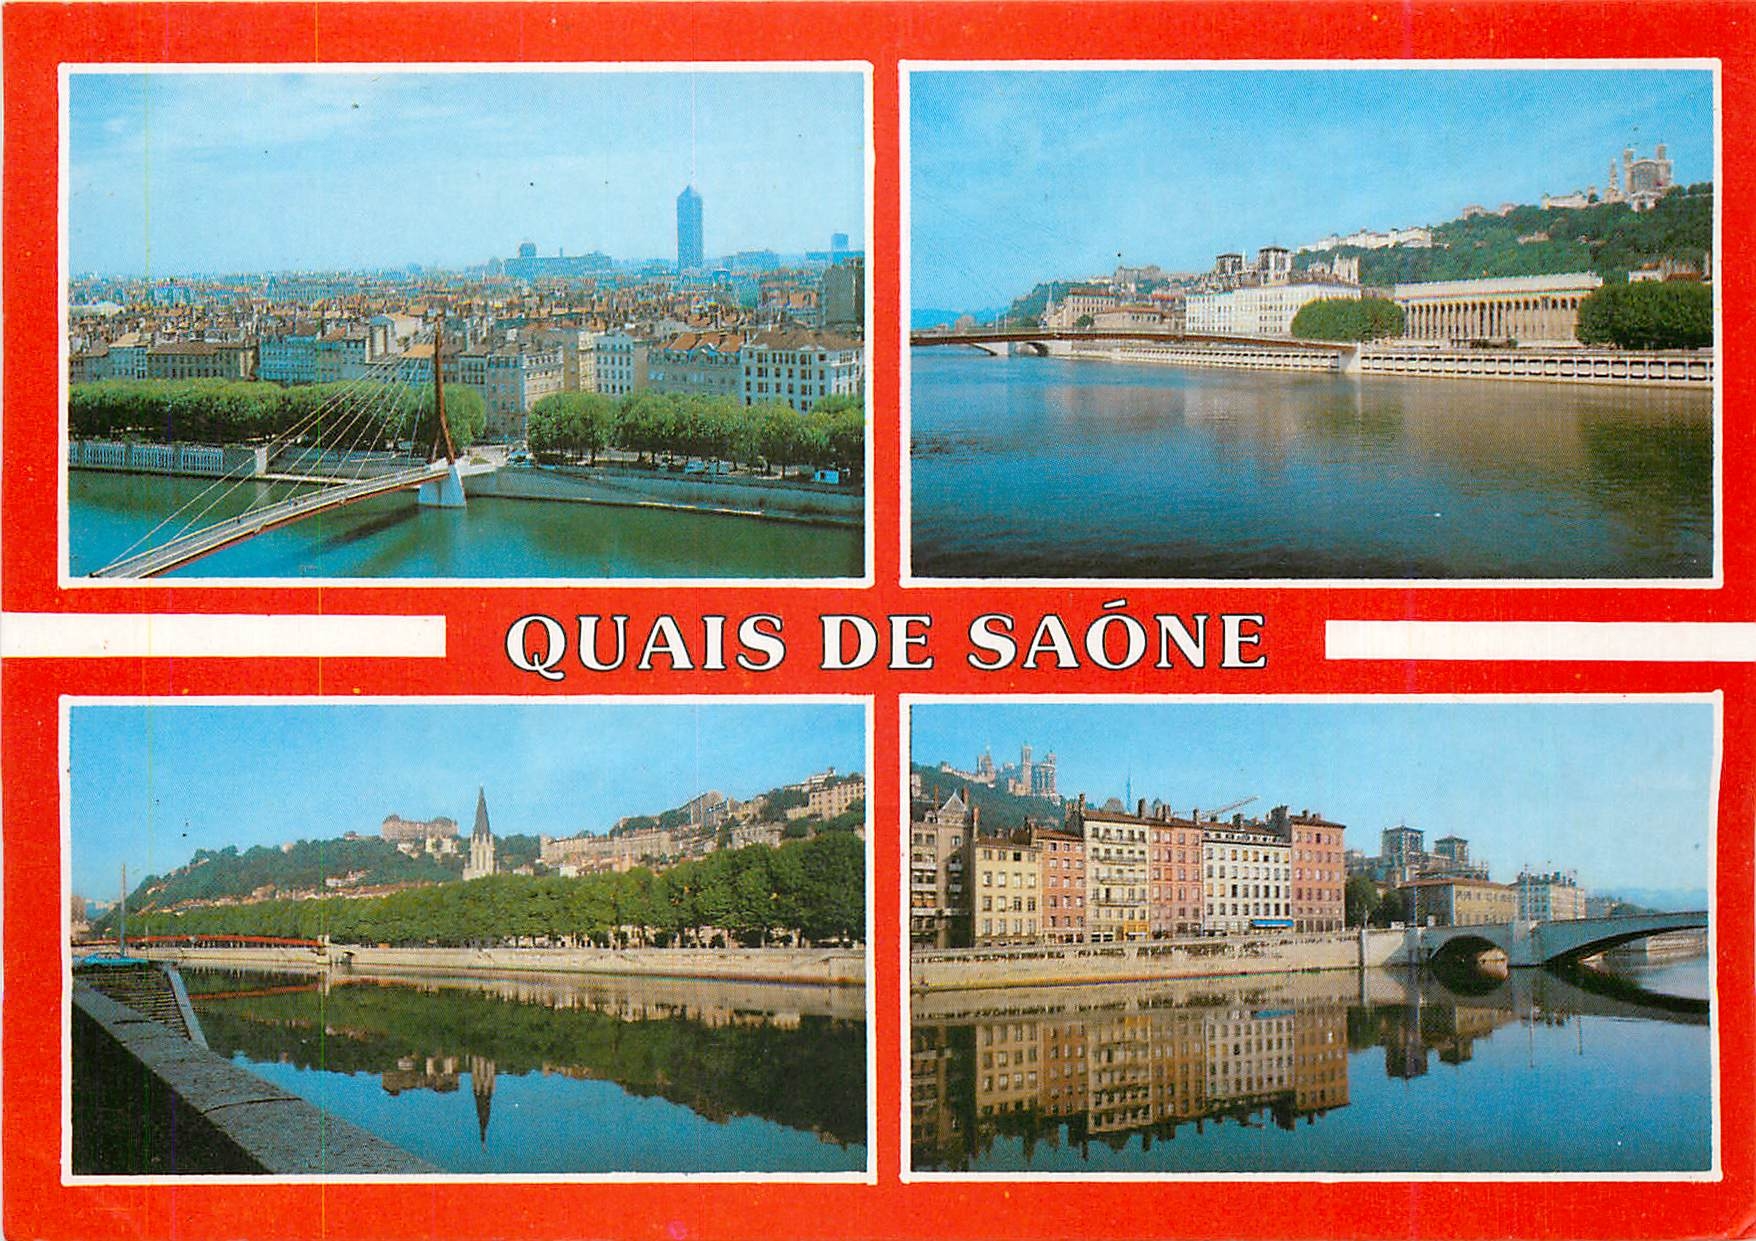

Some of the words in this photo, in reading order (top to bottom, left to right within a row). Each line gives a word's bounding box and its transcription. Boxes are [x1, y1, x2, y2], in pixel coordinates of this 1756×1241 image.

[506, 614, 787, 681] QUAIS
[820, 614, 935, 671] DE
[967, 598, 1268, 671] SAÓNE
